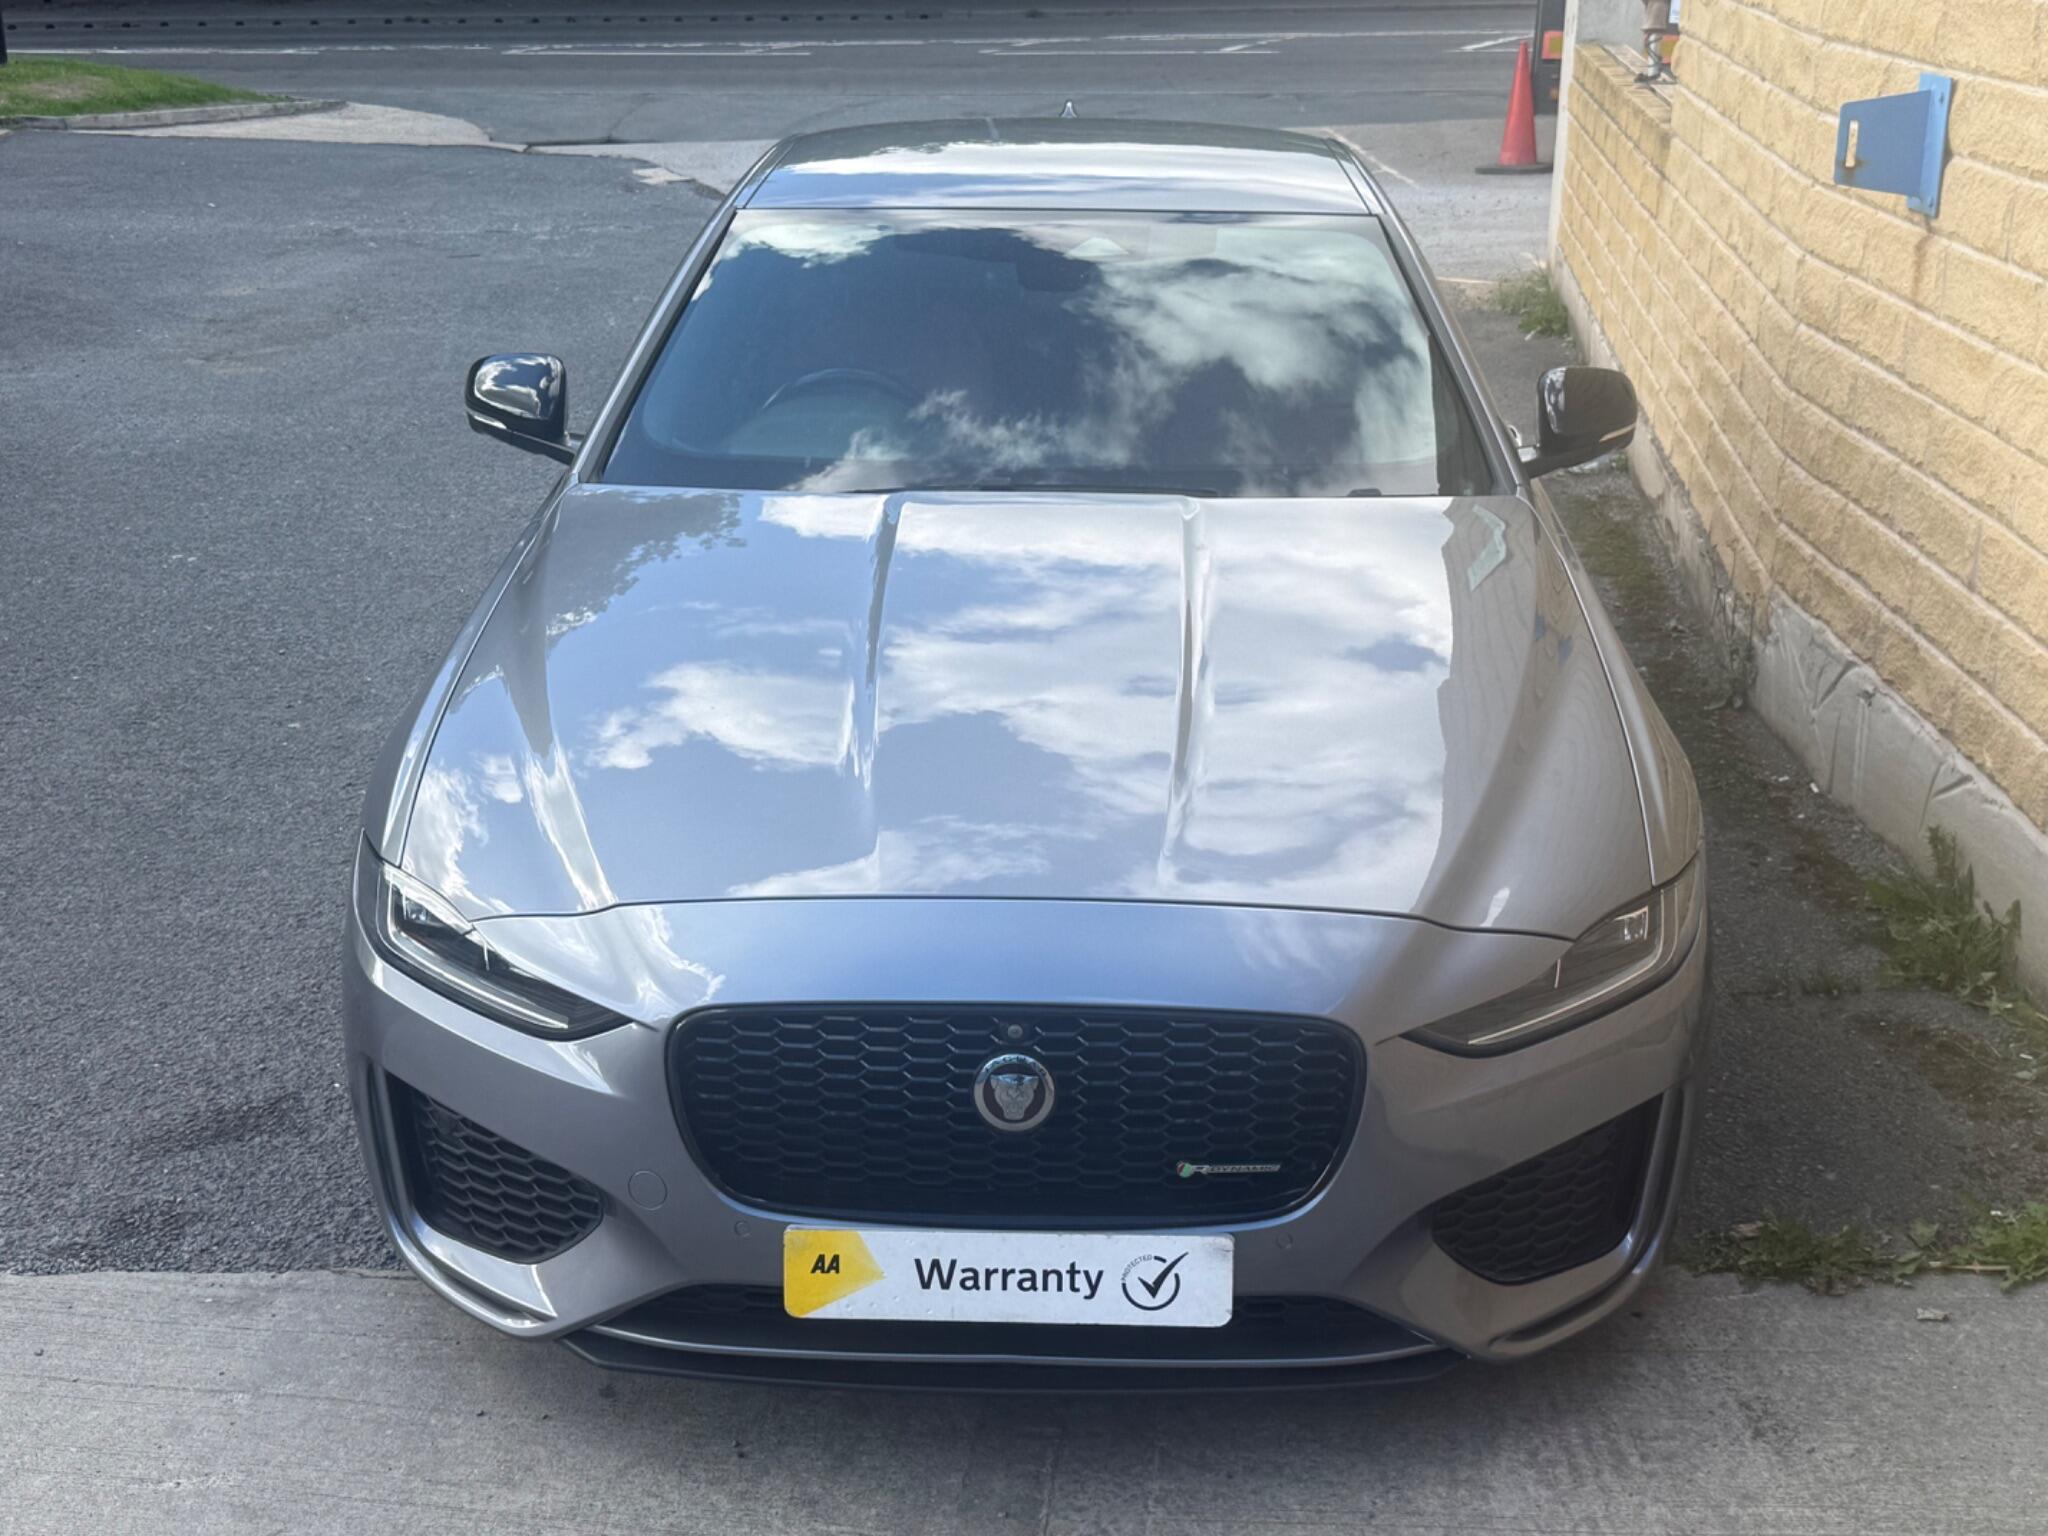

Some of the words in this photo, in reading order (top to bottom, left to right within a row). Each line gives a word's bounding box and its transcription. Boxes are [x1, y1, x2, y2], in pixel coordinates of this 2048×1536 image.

[810, 1253, 840, 1274] AA
[914, 1256, 1104, 1300] Warranty
[1120, 1253, 1153, 1282] PROTECTED
